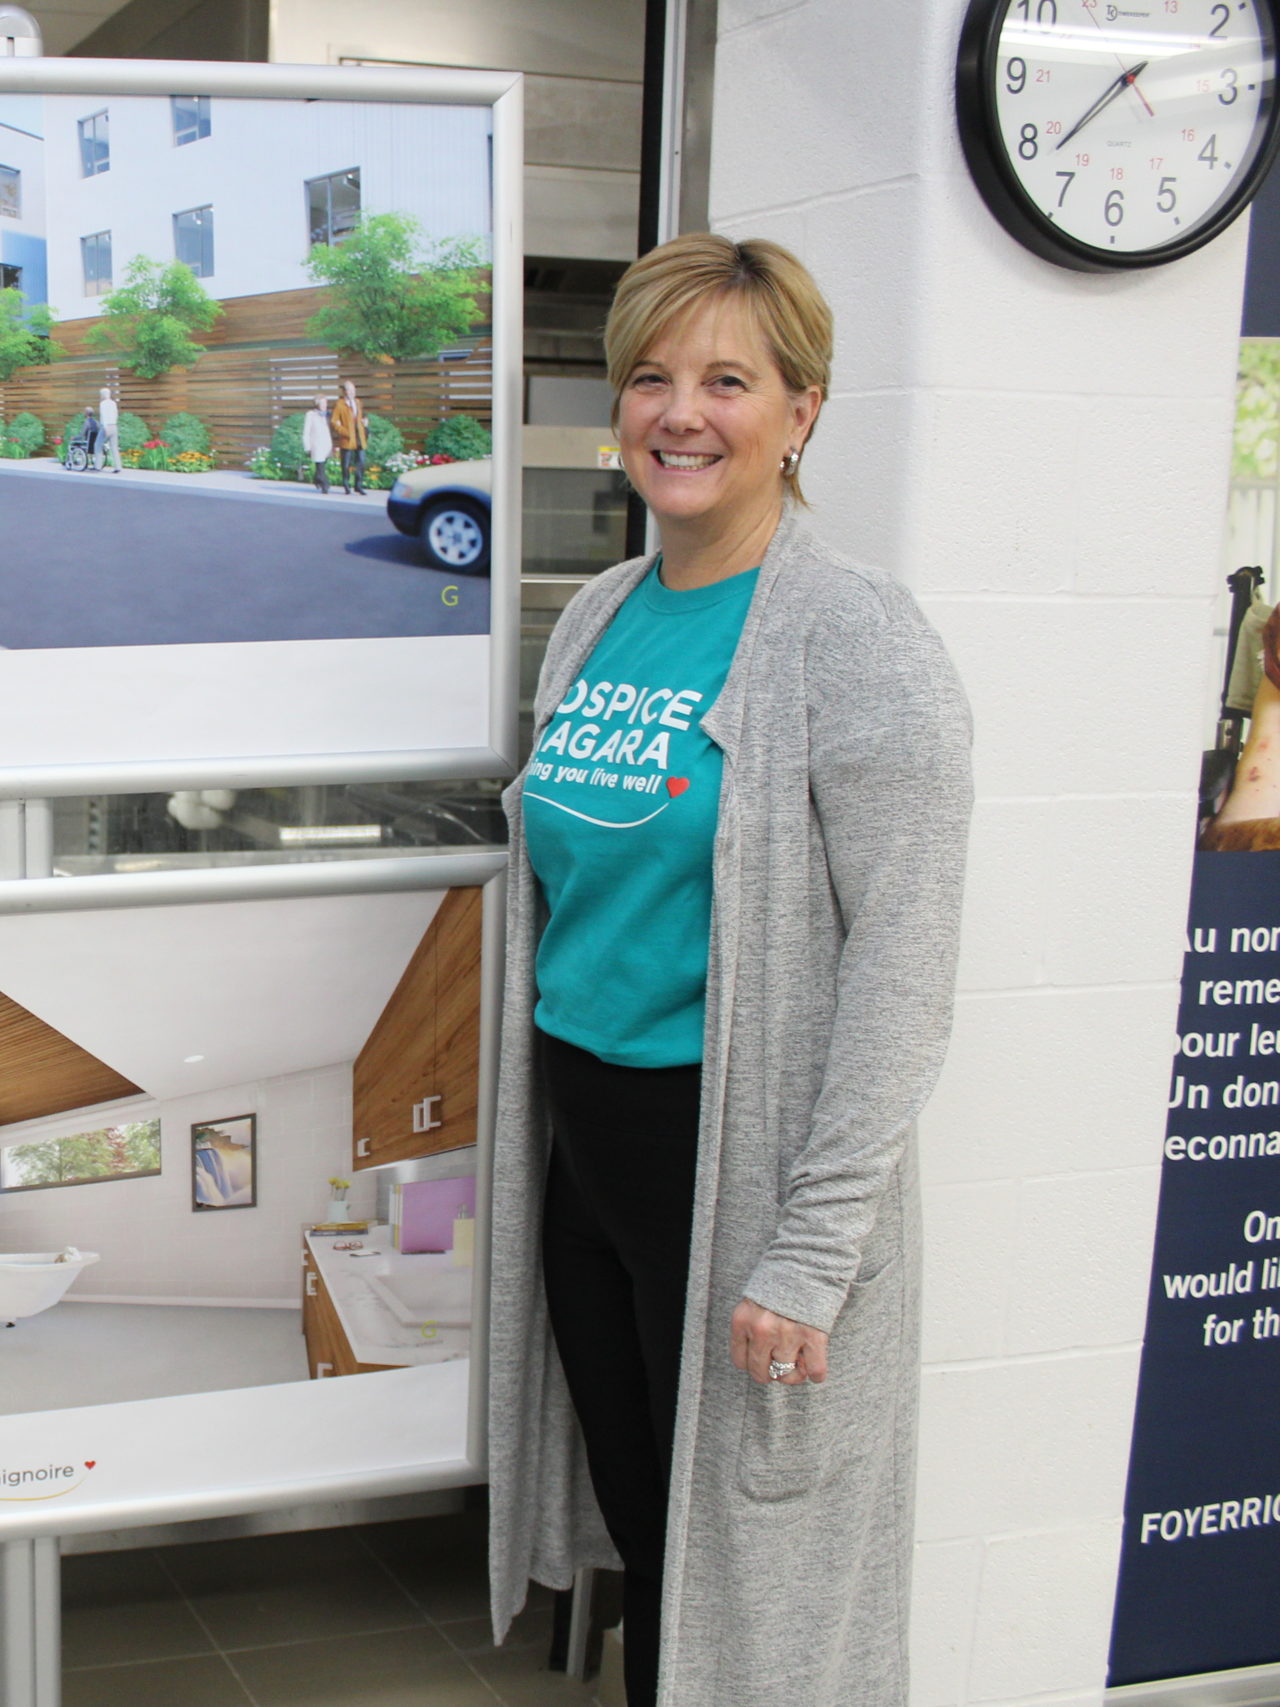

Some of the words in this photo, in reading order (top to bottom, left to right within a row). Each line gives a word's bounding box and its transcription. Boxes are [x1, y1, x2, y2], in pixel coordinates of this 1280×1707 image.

[1017, 0, 1057, 34] 10
[1164, 0, 1178, 13] 13
[1209, 4, 1231, 39] 2
[1006, 57, 1027, 94] 9
[1036, 70, 1051, 83] 21
[1196, 80, 1210, 93] 15
[1218, 68, 1238, 105] 3
[1018, 123, 1038, 160] 8
[1046, 121, 1062, 135] 20
[1182, 129, 1195, 142] 16
[1075, 153, 1090, 167] 19
[1150, 158, 1163, 170] 17
[1197, 134, 1218, 170] 4
[1056, 171, 1076, 207] 7
[1110, 168, 1124, 180] 18
[1104, 190, 1124, 227] 6
[1156, 177, 1177, 213] 5
[441, 585, 459, 607] G
[554, 765, 589, 783] you
[590, 768, 619, 788] live
[623, 774, 663, 795] well
[1249, 1022, 1280, 1056] le
[1222, 1075, 1280, 1109] don
[1163, 1260, 1254, 1299] would
[1261, 1256, 1280, 1290] li
[1202, 1314, 1244, 1346] for
[1252, 1306, 1280, 1339] th
